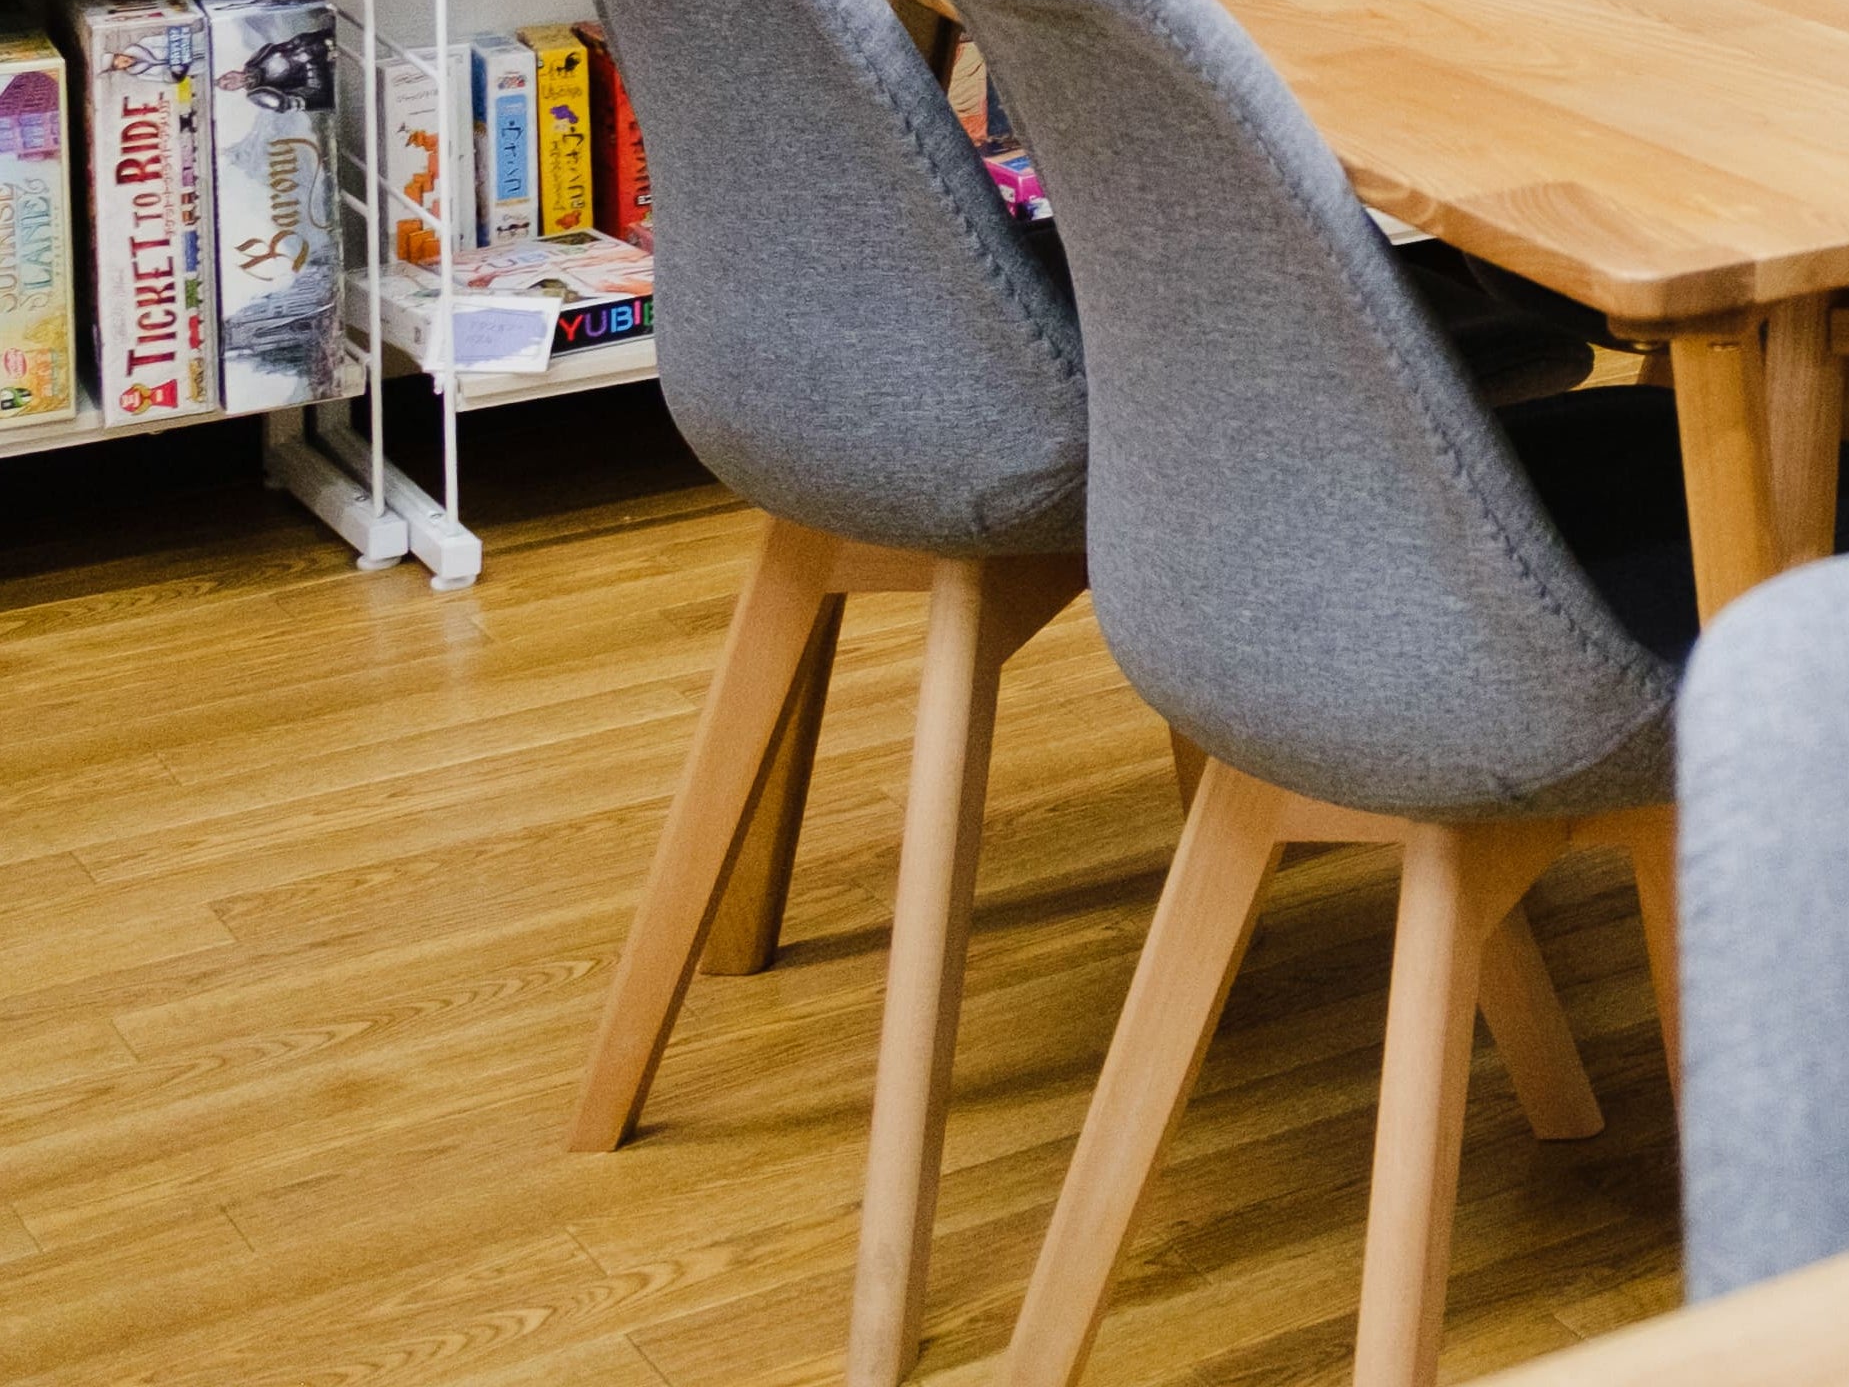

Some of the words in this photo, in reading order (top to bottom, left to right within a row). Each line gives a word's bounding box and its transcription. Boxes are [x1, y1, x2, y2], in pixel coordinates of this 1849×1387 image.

[115, 95, 165, 186] RIDE
[20, 194, 51, 295] LANE
[133, 190, 162, 232] TO
[235, 137, 331, 283] Barony
[127, 234, 177, 377] TICKET
